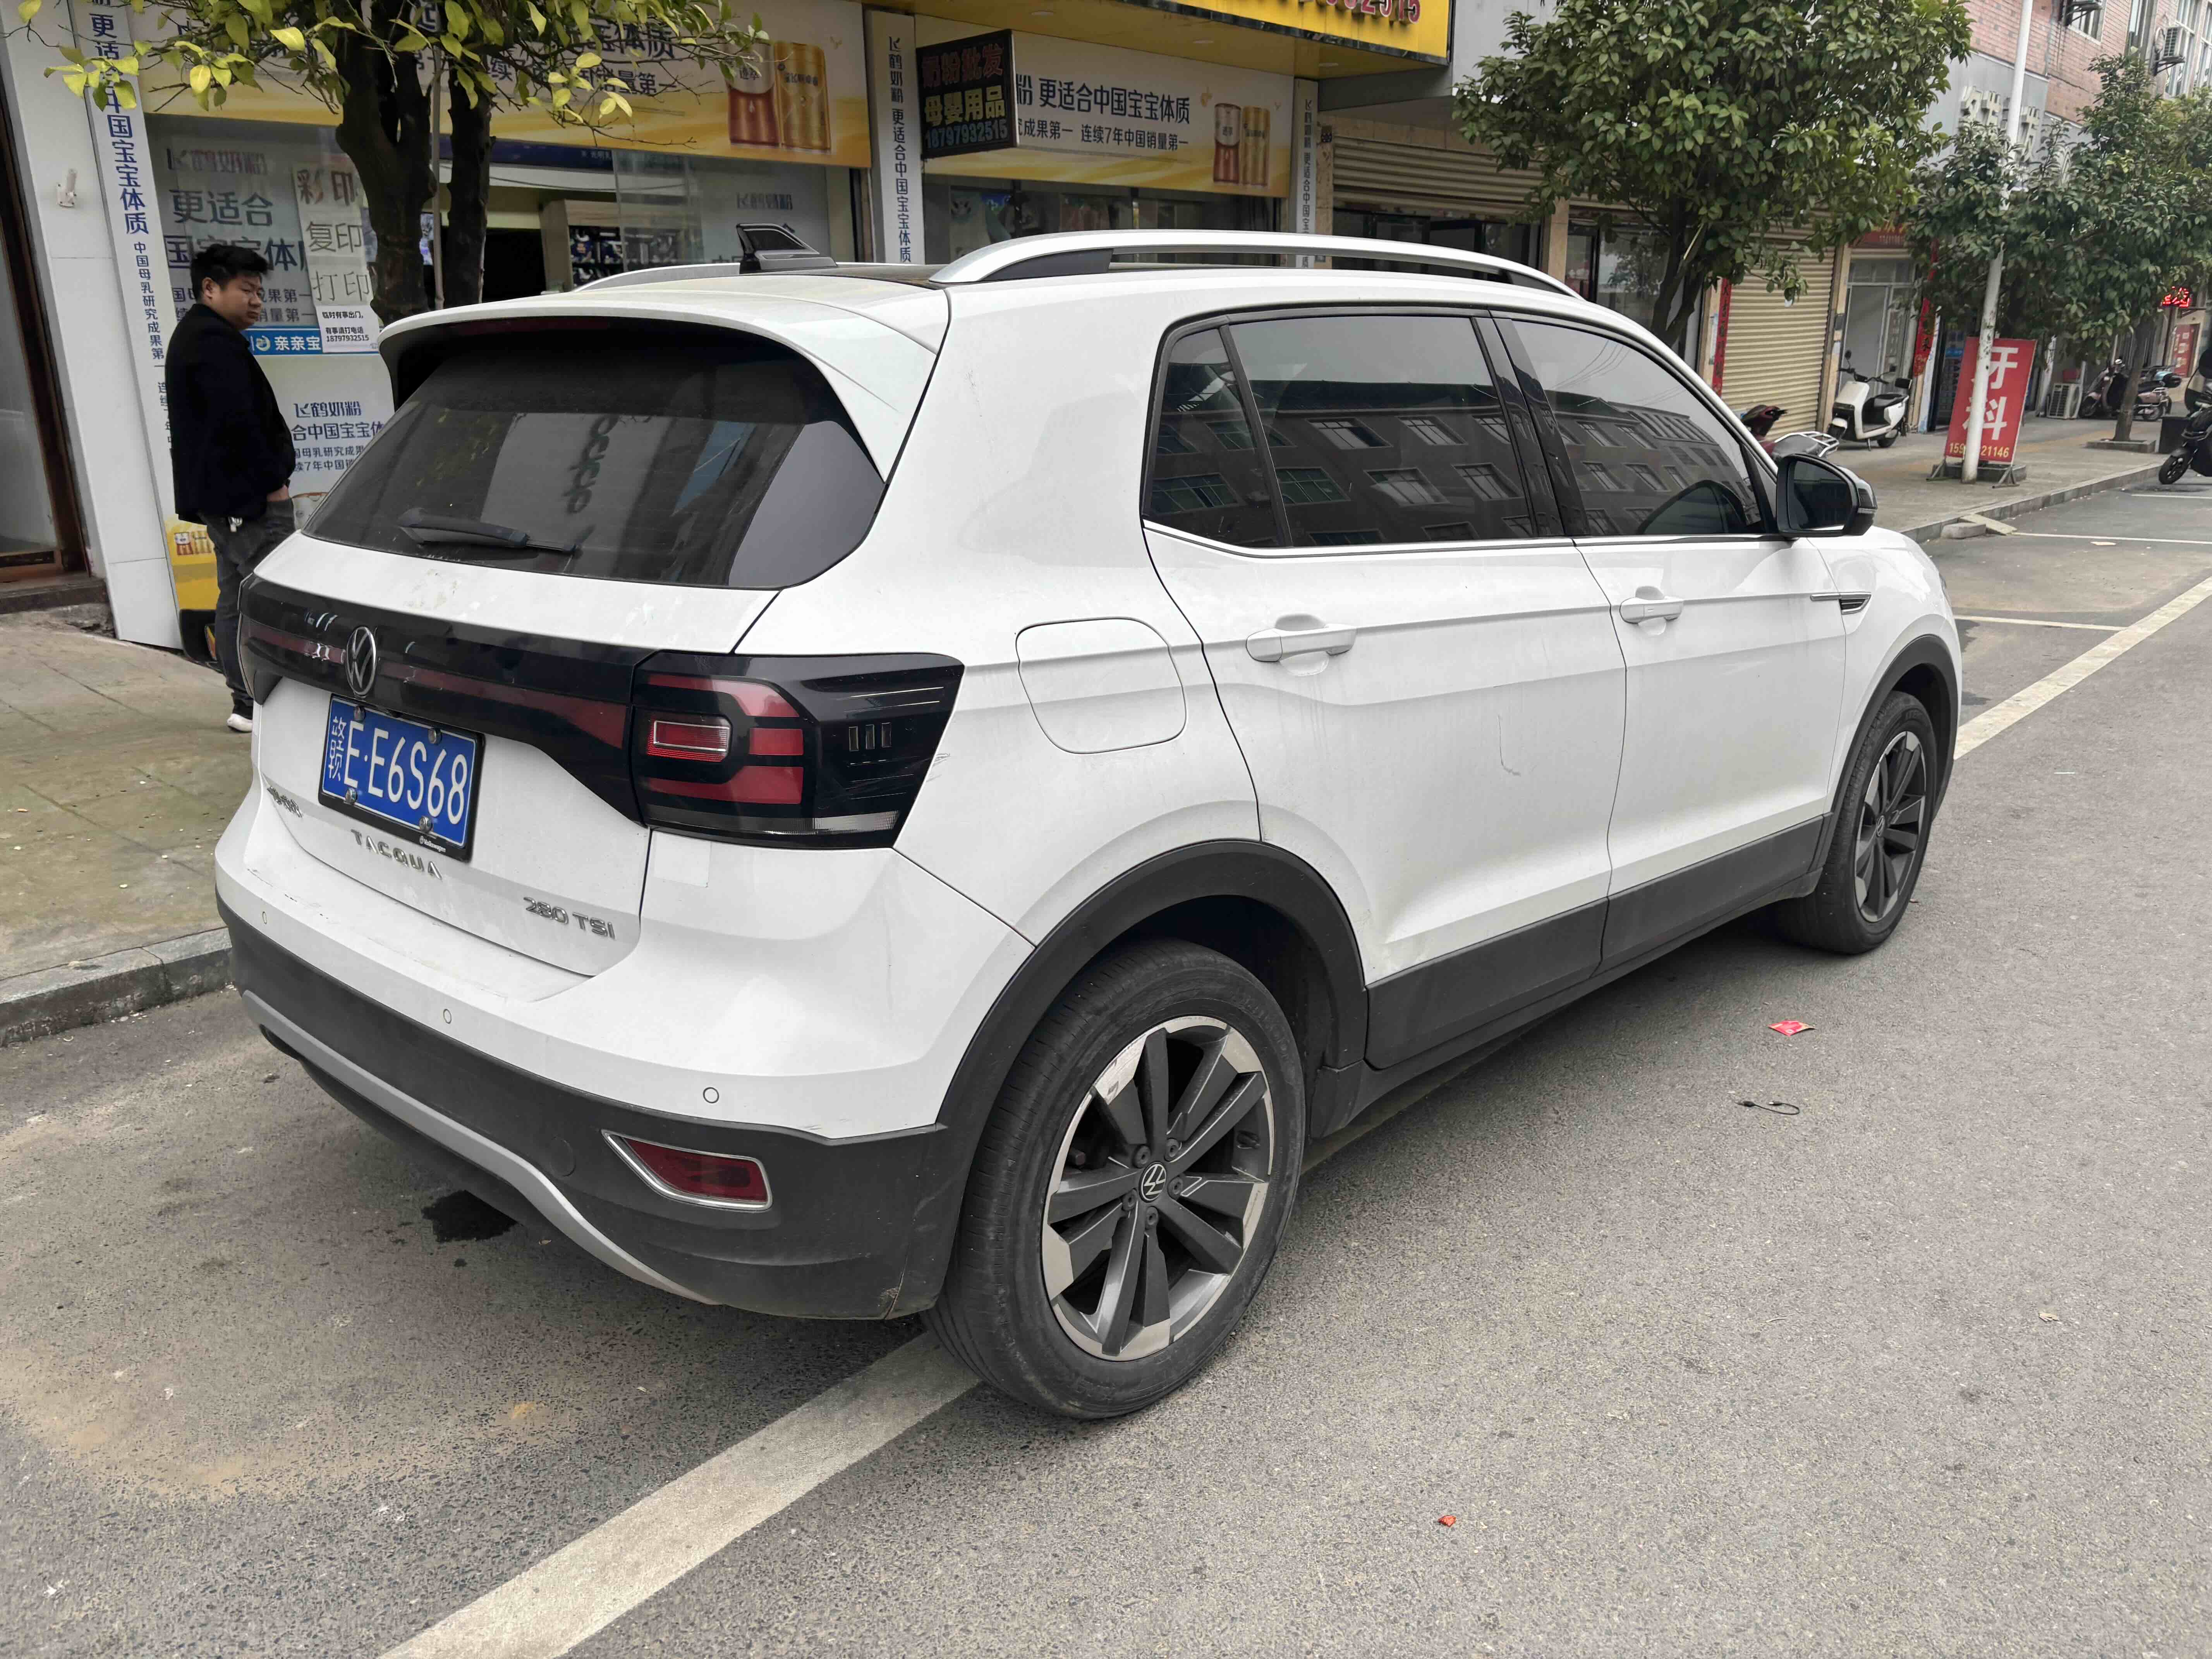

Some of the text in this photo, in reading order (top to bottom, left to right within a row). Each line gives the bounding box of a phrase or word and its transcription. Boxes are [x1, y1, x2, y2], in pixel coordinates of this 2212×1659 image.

[924, 85, 1006, 127] 母婴用品
[1039, 78, 1190, 124] 更适合中国宝宝体质
[924, 118, 1008, 148] 18797932515
[1081, 124, 1188, 151] 连续7年中国销量第一
[297, 169, 358, 205] 彩印
[892, 108, 911, 263] 更适合中国宝宝体质
[169, 189, 273, 227] 更适合
[305, 221, 362, 253] 复印
[134, 241, 165, 367] 中国母乳研究成果第一
[311, 271, 370, 301] 打印
[274, 335, 321, 350] 亲亲宝
[293, 401, 362, 418] 飞鹤奶粉
[350, 829, 443, 881] TACQUA
[523, 896, 616, 939] 280 TSI
